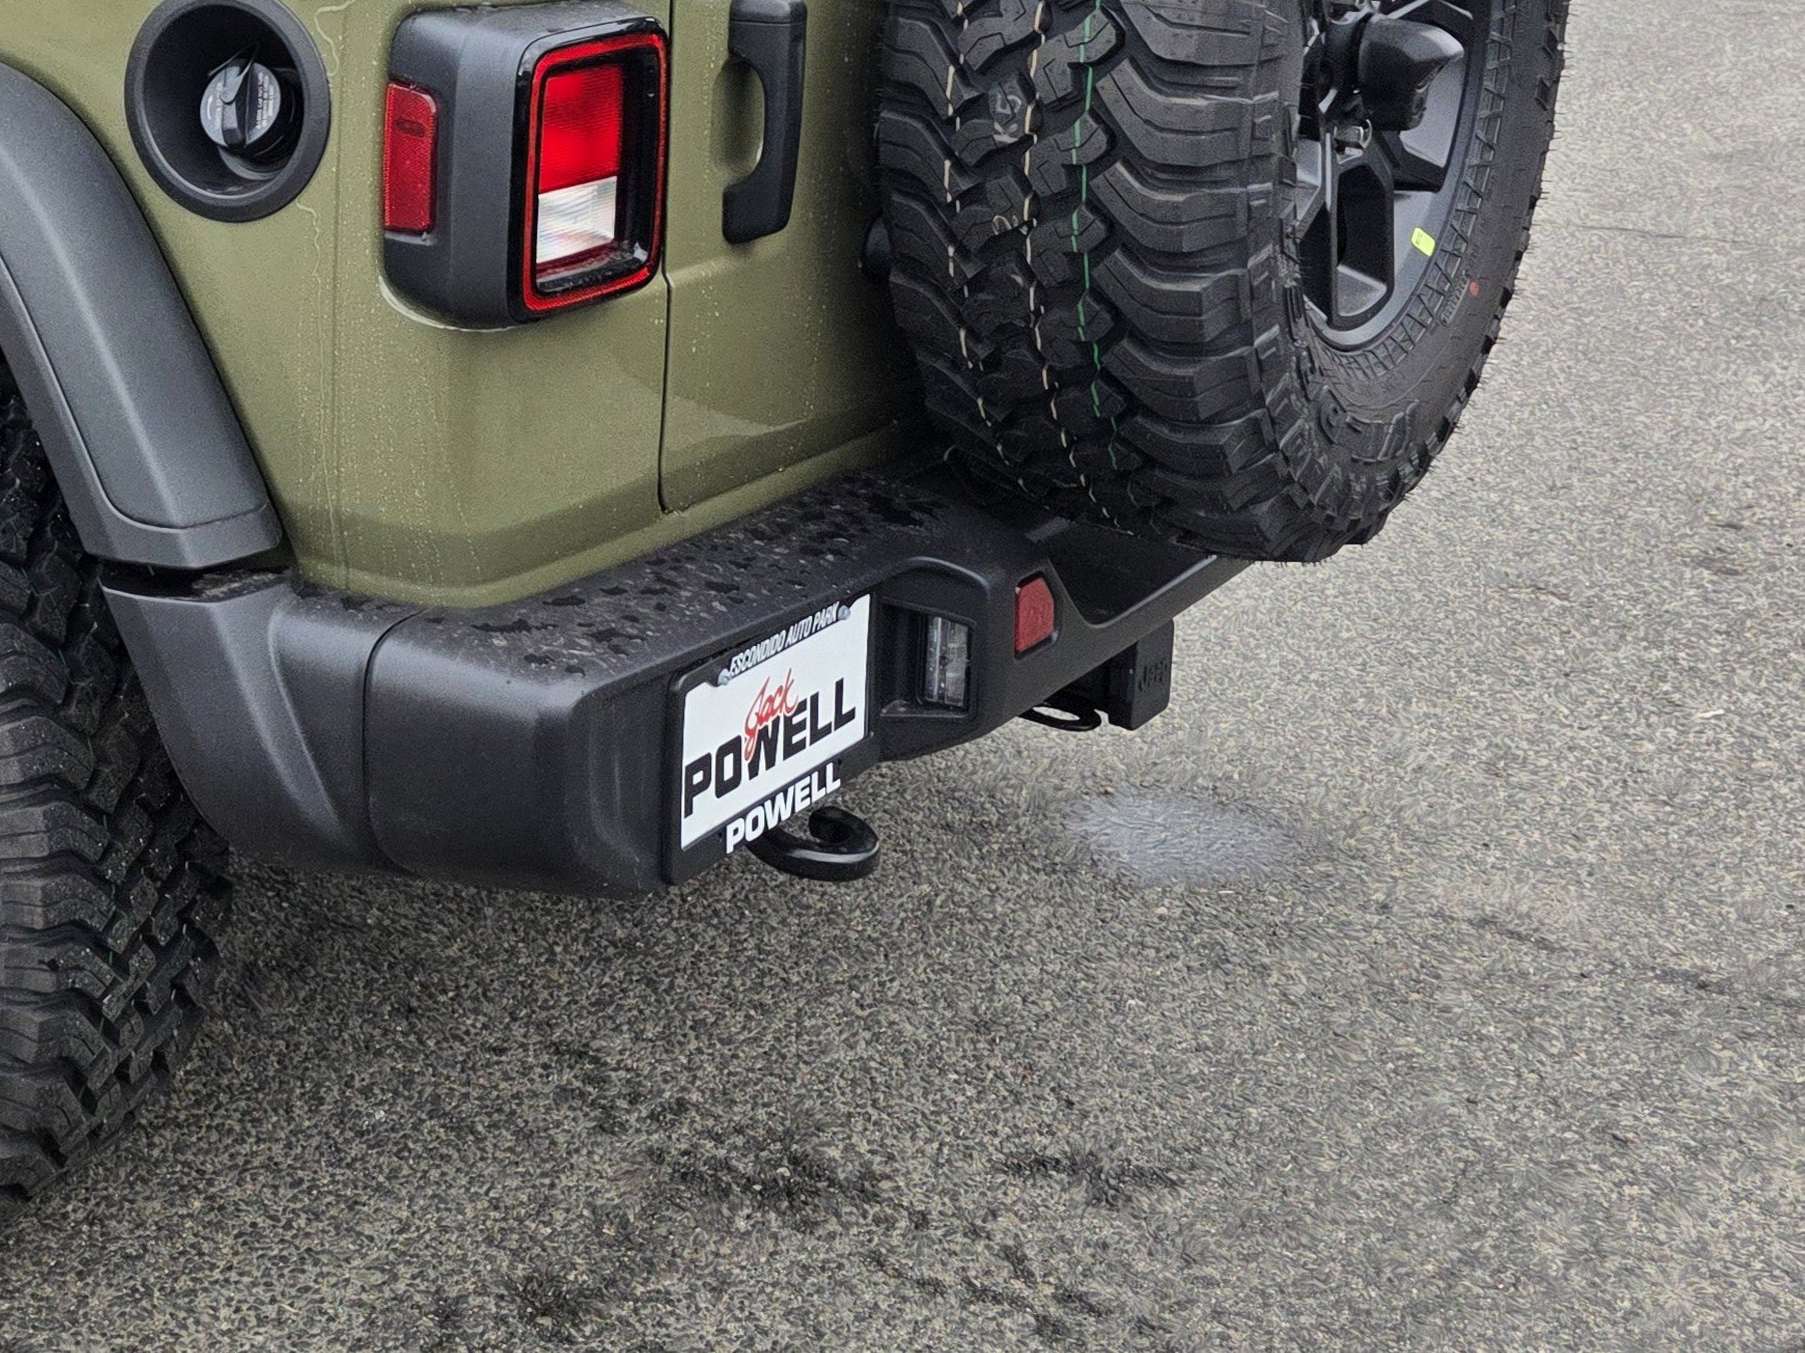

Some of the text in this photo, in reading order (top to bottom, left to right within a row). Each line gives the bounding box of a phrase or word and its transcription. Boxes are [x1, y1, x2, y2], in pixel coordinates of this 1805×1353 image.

[729, 601, 840, 677] ESCONDIDO AUTO PARK
[683, 677, 856, 819] POWELL
[744, 667, 799, 762] Jack
[726, 763, 841, 854] POWELL
